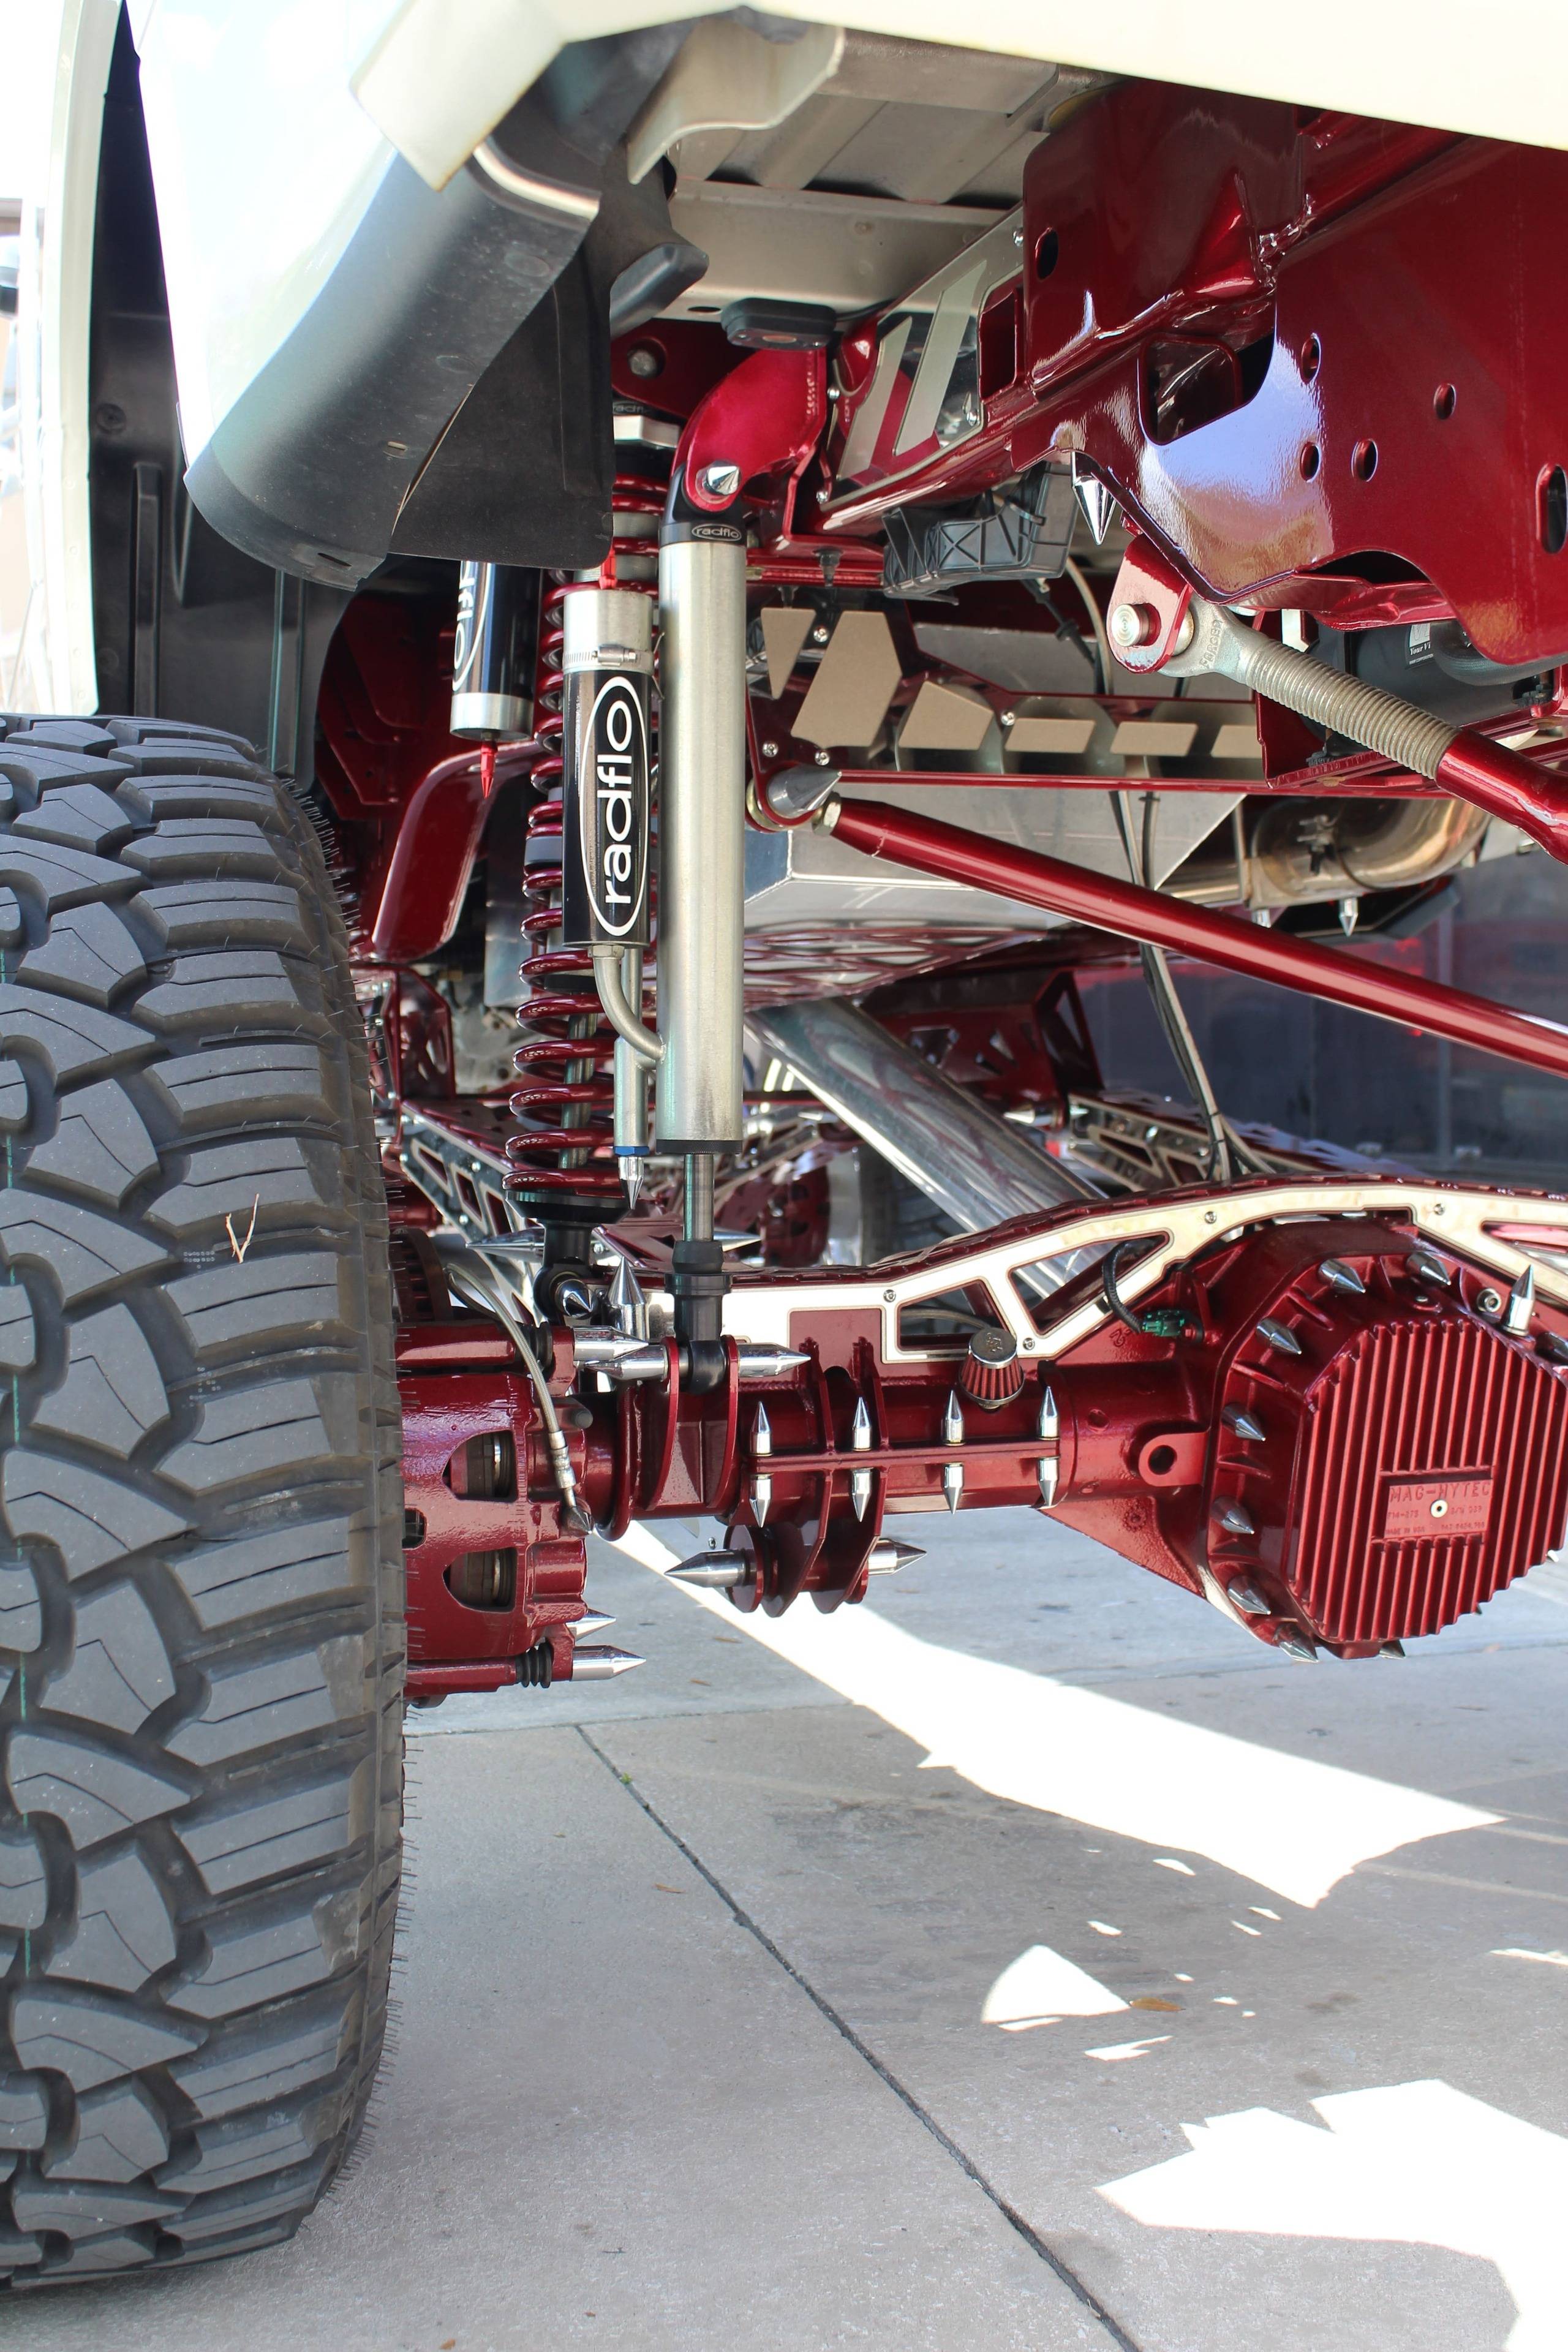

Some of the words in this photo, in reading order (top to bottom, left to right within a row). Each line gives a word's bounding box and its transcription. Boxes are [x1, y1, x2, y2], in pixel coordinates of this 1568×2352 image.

[696, 527, 739, 538] radflo
[1410, 646, 1423, 655] Your
[597, 700, 632, 904] radflo
[1390, 1482, 1490, 1502] MAG-HYTEC
